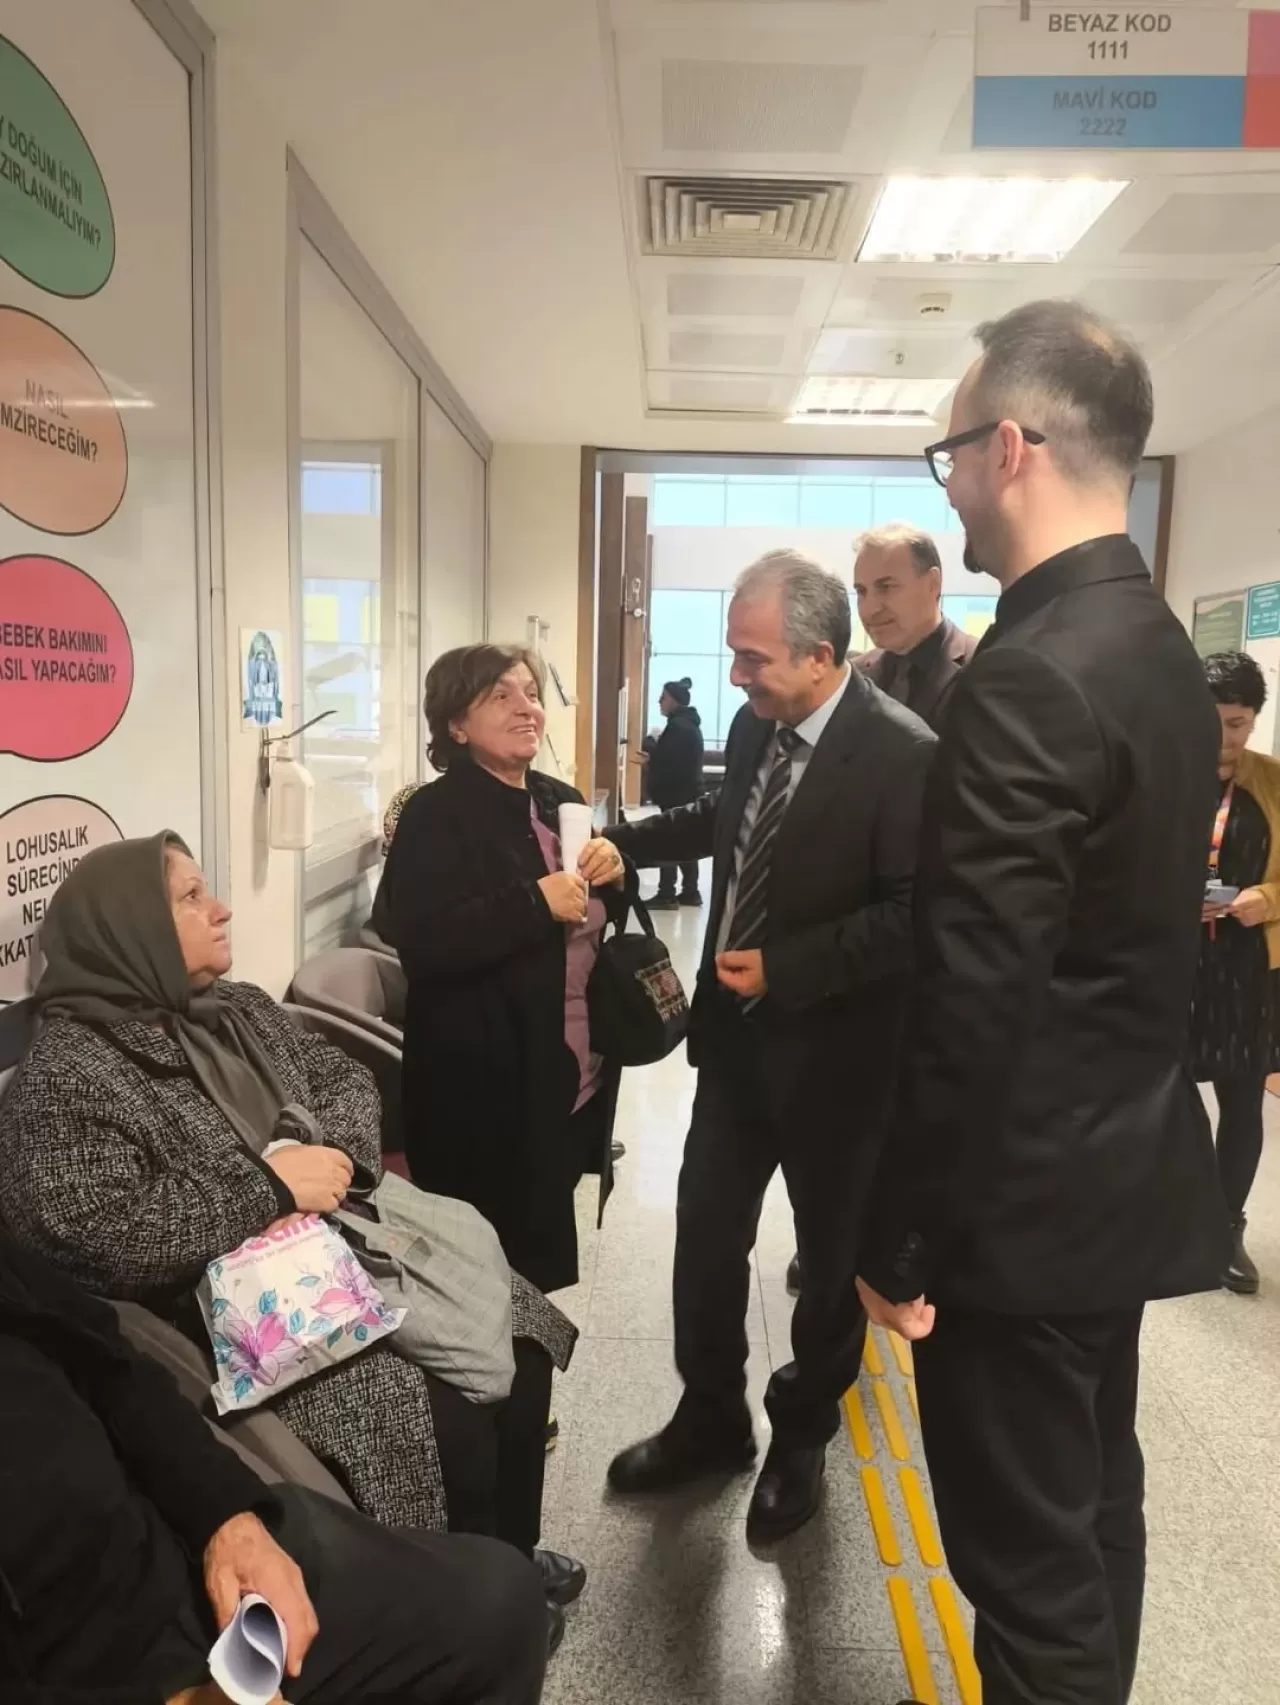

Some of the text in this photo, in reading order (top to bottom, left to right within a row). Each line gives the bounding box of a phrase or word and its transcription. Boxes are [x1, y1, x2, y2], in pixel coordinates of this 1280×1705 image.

[1048, 14, 1172, 32] BEYAZ KOD
[1087, 40, 1129, 59] 1111
[1053, 86, 1158, 109] MAVİ KOD
[1080, 118, 1127, 136] 2222
[8, 120, 57, 183] DOĞUM
[59, 160, 83, 204] İÇİN
[26, 378, 70, 420] NASIL
[0, 623, 108, 653] EBEK BAKIMINI
[31, 657, 117, 684] YAPACAĞIM?
[7, 825, 89, 864] LOHUSALIK
